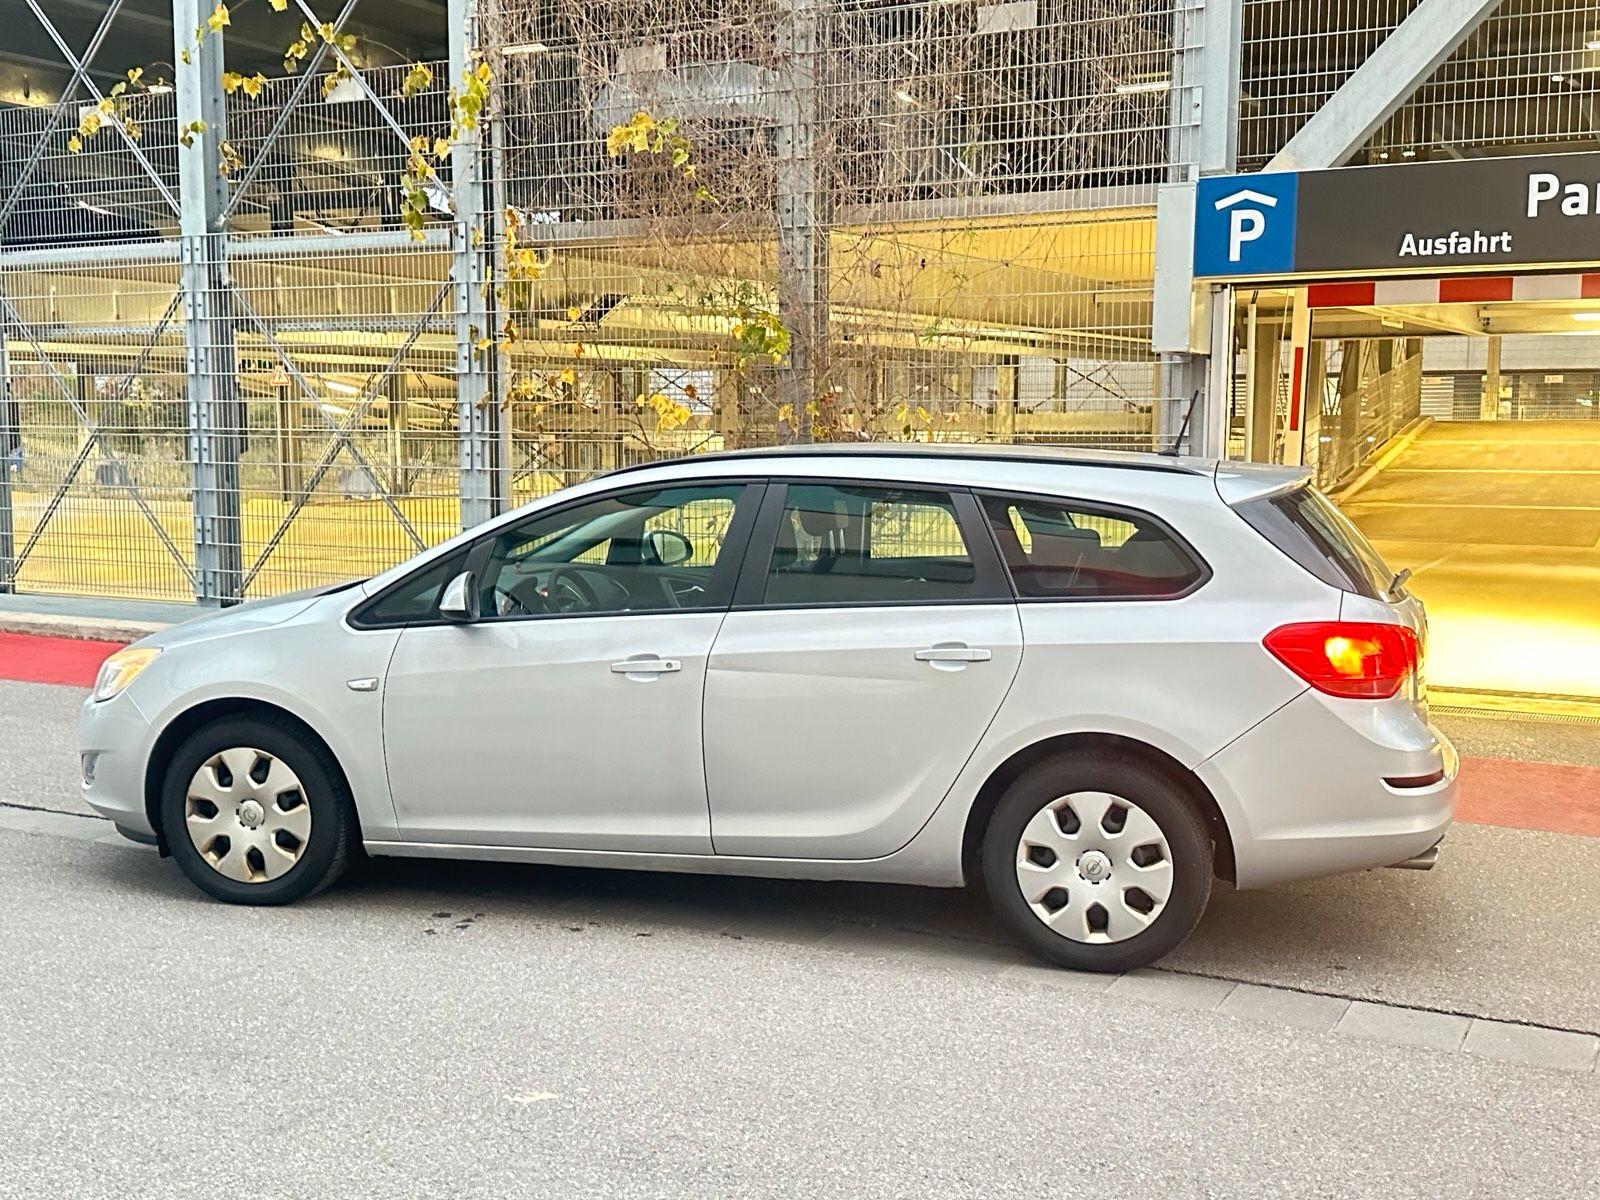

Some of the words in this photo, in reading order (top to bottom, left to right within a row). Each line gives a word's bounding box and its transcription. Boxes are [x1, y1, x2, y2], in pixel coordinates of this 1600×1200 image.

[1527, 173, 1600, 217] Pa
[1229, 209, 1265, 262] P
[1399, 230, 1512, 256] Ausfahrt
